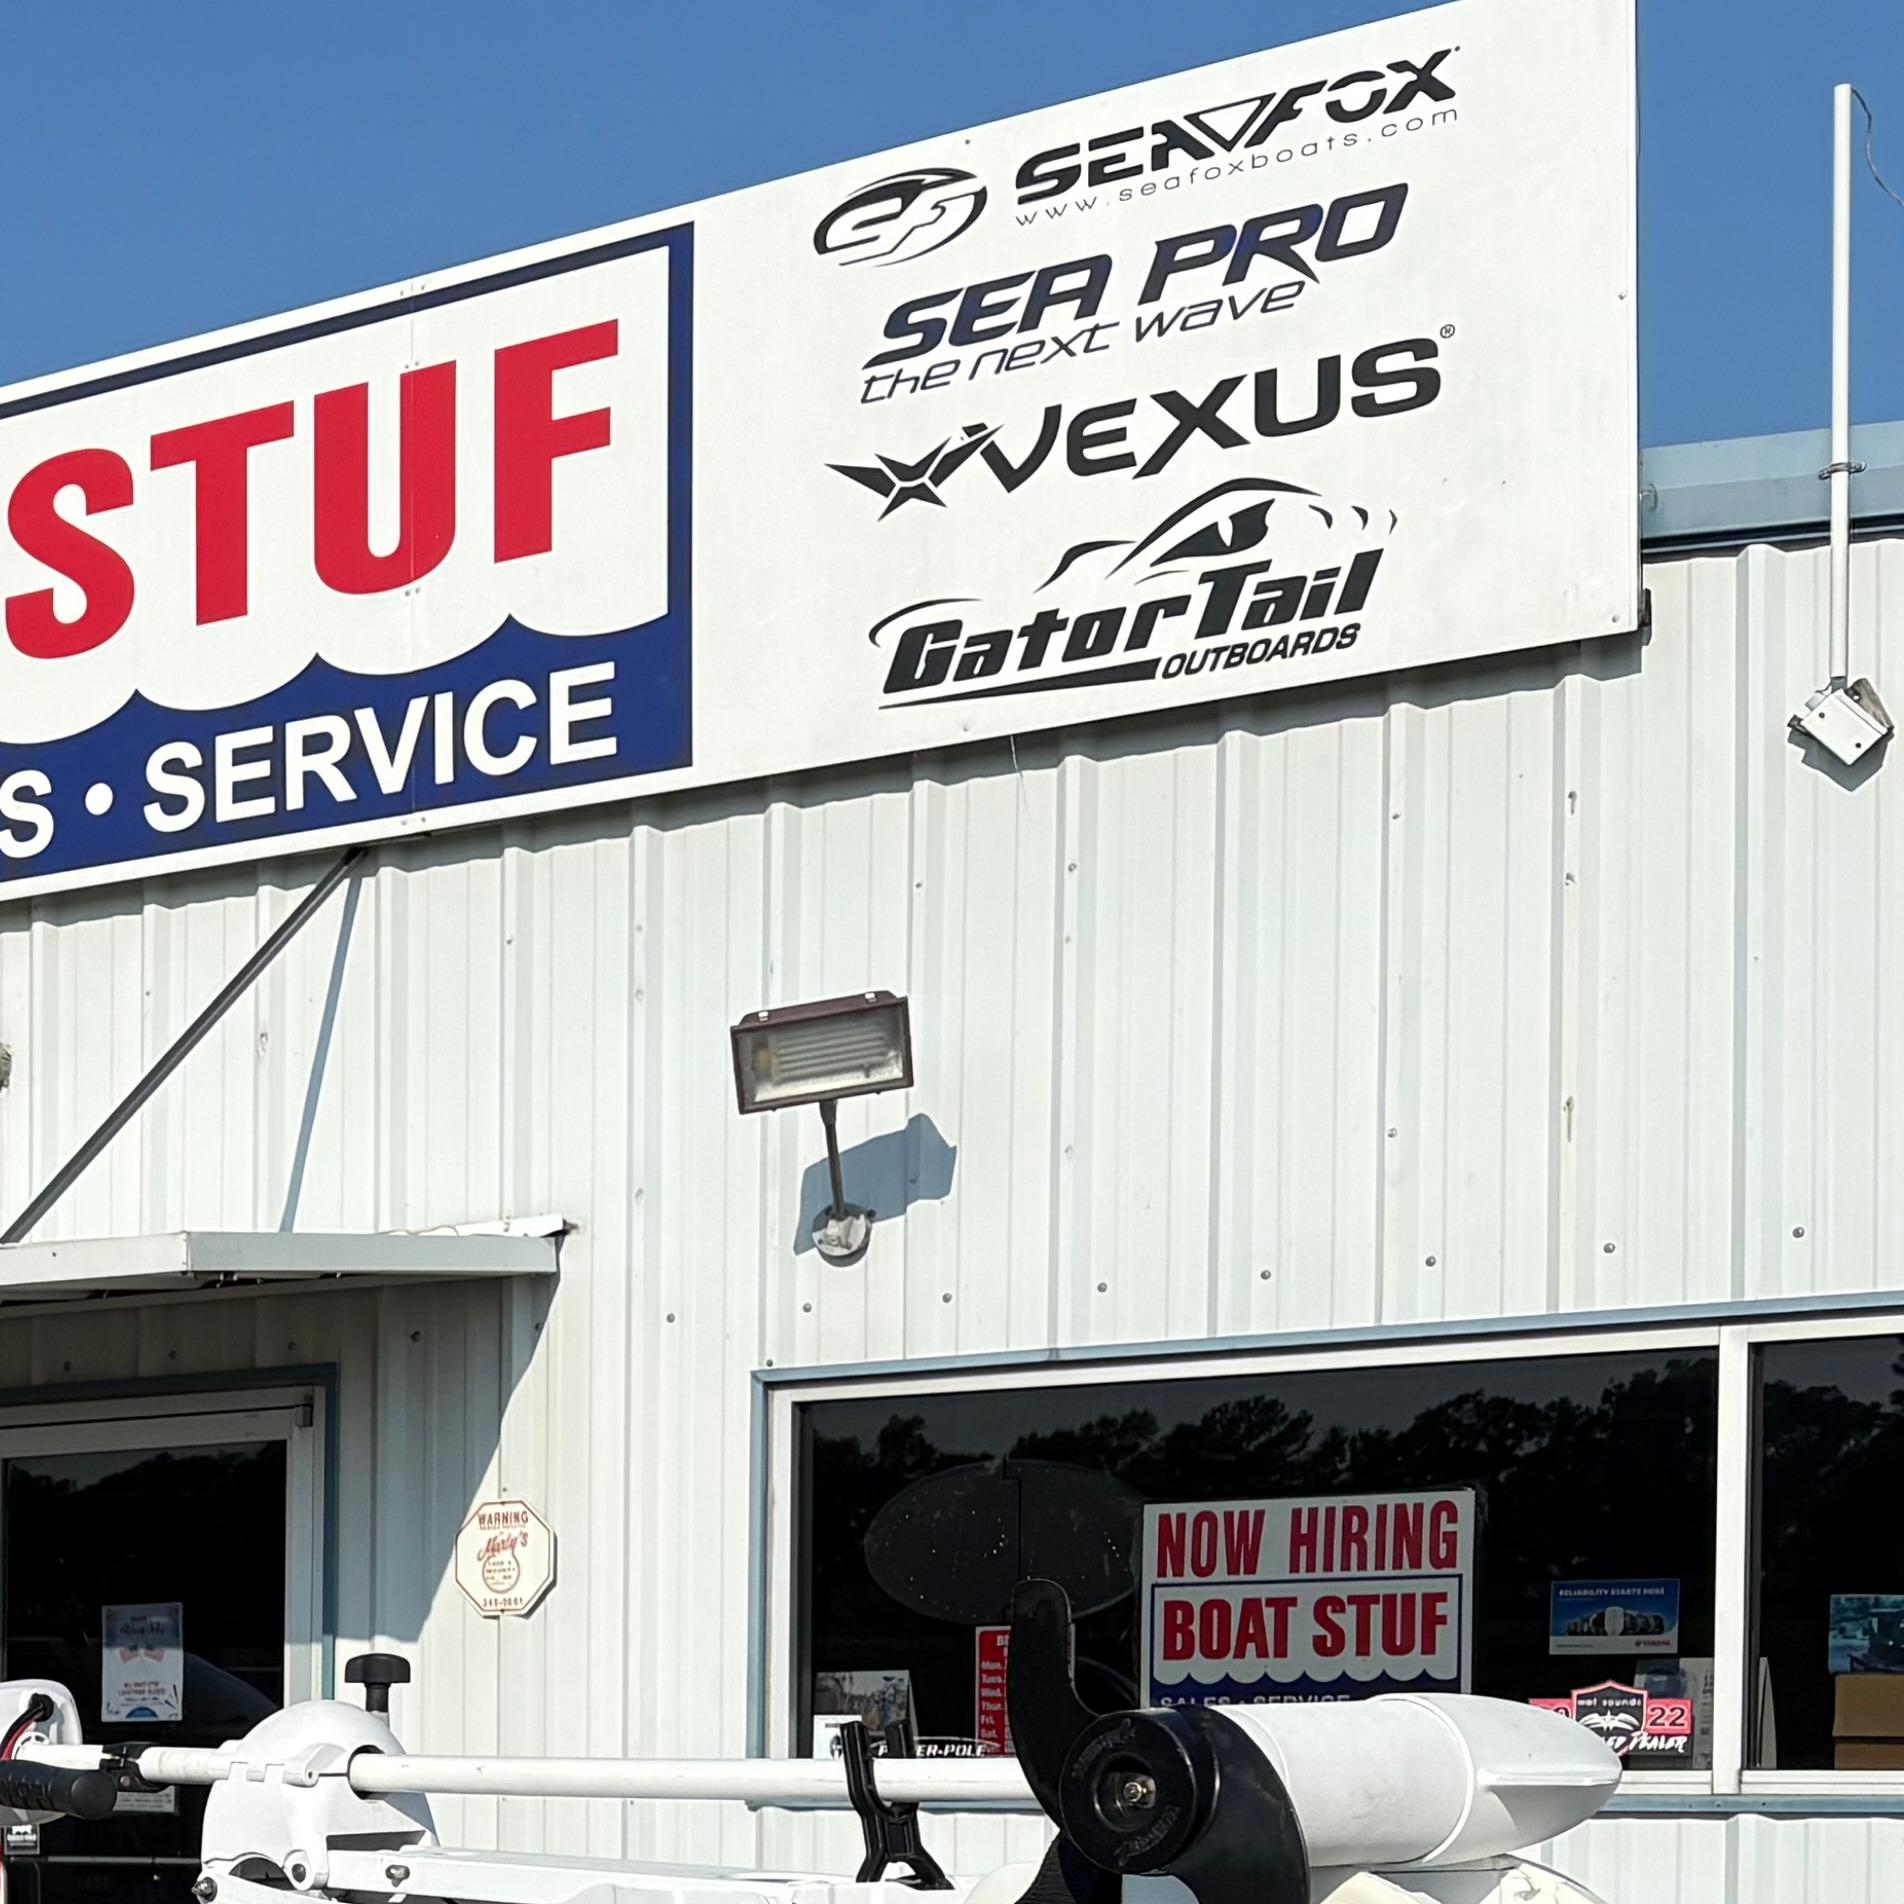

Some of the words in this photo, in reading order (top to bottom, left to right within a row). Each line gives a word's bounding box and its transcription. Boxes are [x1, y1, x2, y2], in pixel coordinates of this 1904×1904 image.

[1243, 47, 1457, 149] FOX
[1015, 108, 1459, 228] www.seafoxboats.com
[861, 251, 1113, 371] SEA
[1137, 182, 1410, 307] PRO
[860, 359, 963, 406] the
[968, 318, 1119, 378] next
[1133, 279, 1306, 345] wave
[970, 337, 1442, 494] VEXUS
[4, 317, 620, 661] STUF
[880, 547, 1387, 696] GatorTail
[1158, 621, 1363, 682] OUTBOARDS
[142, 660, 619, 836] SERVICE
[478, 1510, 529, 1526] WARNING
[1157, 1509, 1266, 1579] NOW
[1288, 1500, 1459, 1575] HIRING
[1162, 1596, 1298, 1661] BOAT
[1312, 1591, 1449, 1658] STUF
[1558, 1588, 1609, 1598] RELIABILITY
[1610, 1587, 1642, 1597] STARTS
[1642, 1586, 1665, 1596] HERE
[1648, 1706, 1686, 1728] 22
